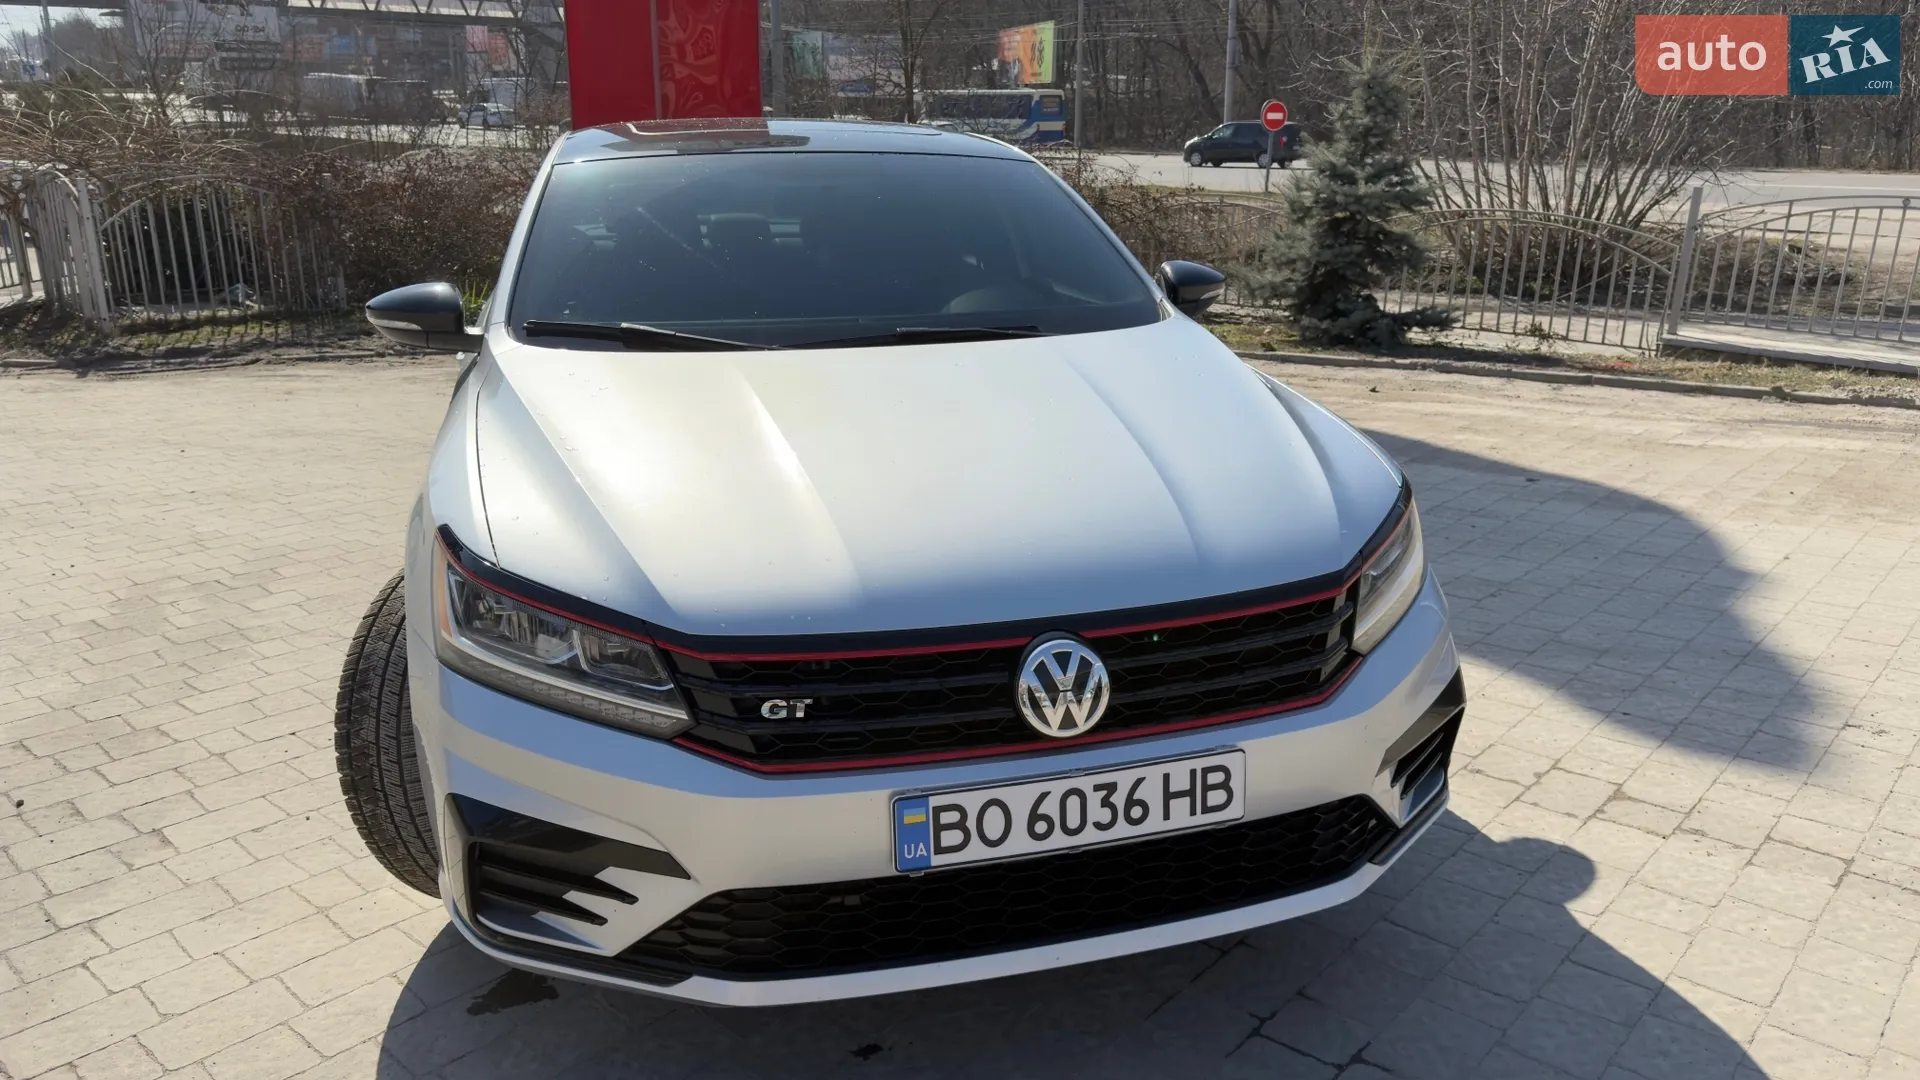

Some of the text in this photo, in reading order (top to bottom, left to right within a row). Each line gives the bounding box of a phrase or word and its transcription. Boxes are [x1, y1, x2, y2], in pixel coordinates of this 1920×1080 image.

[761, 699, 813, 719] GT
[932, 764, 1234, 855] BO 6036 HB
[904, 842, 927, 859] UA
